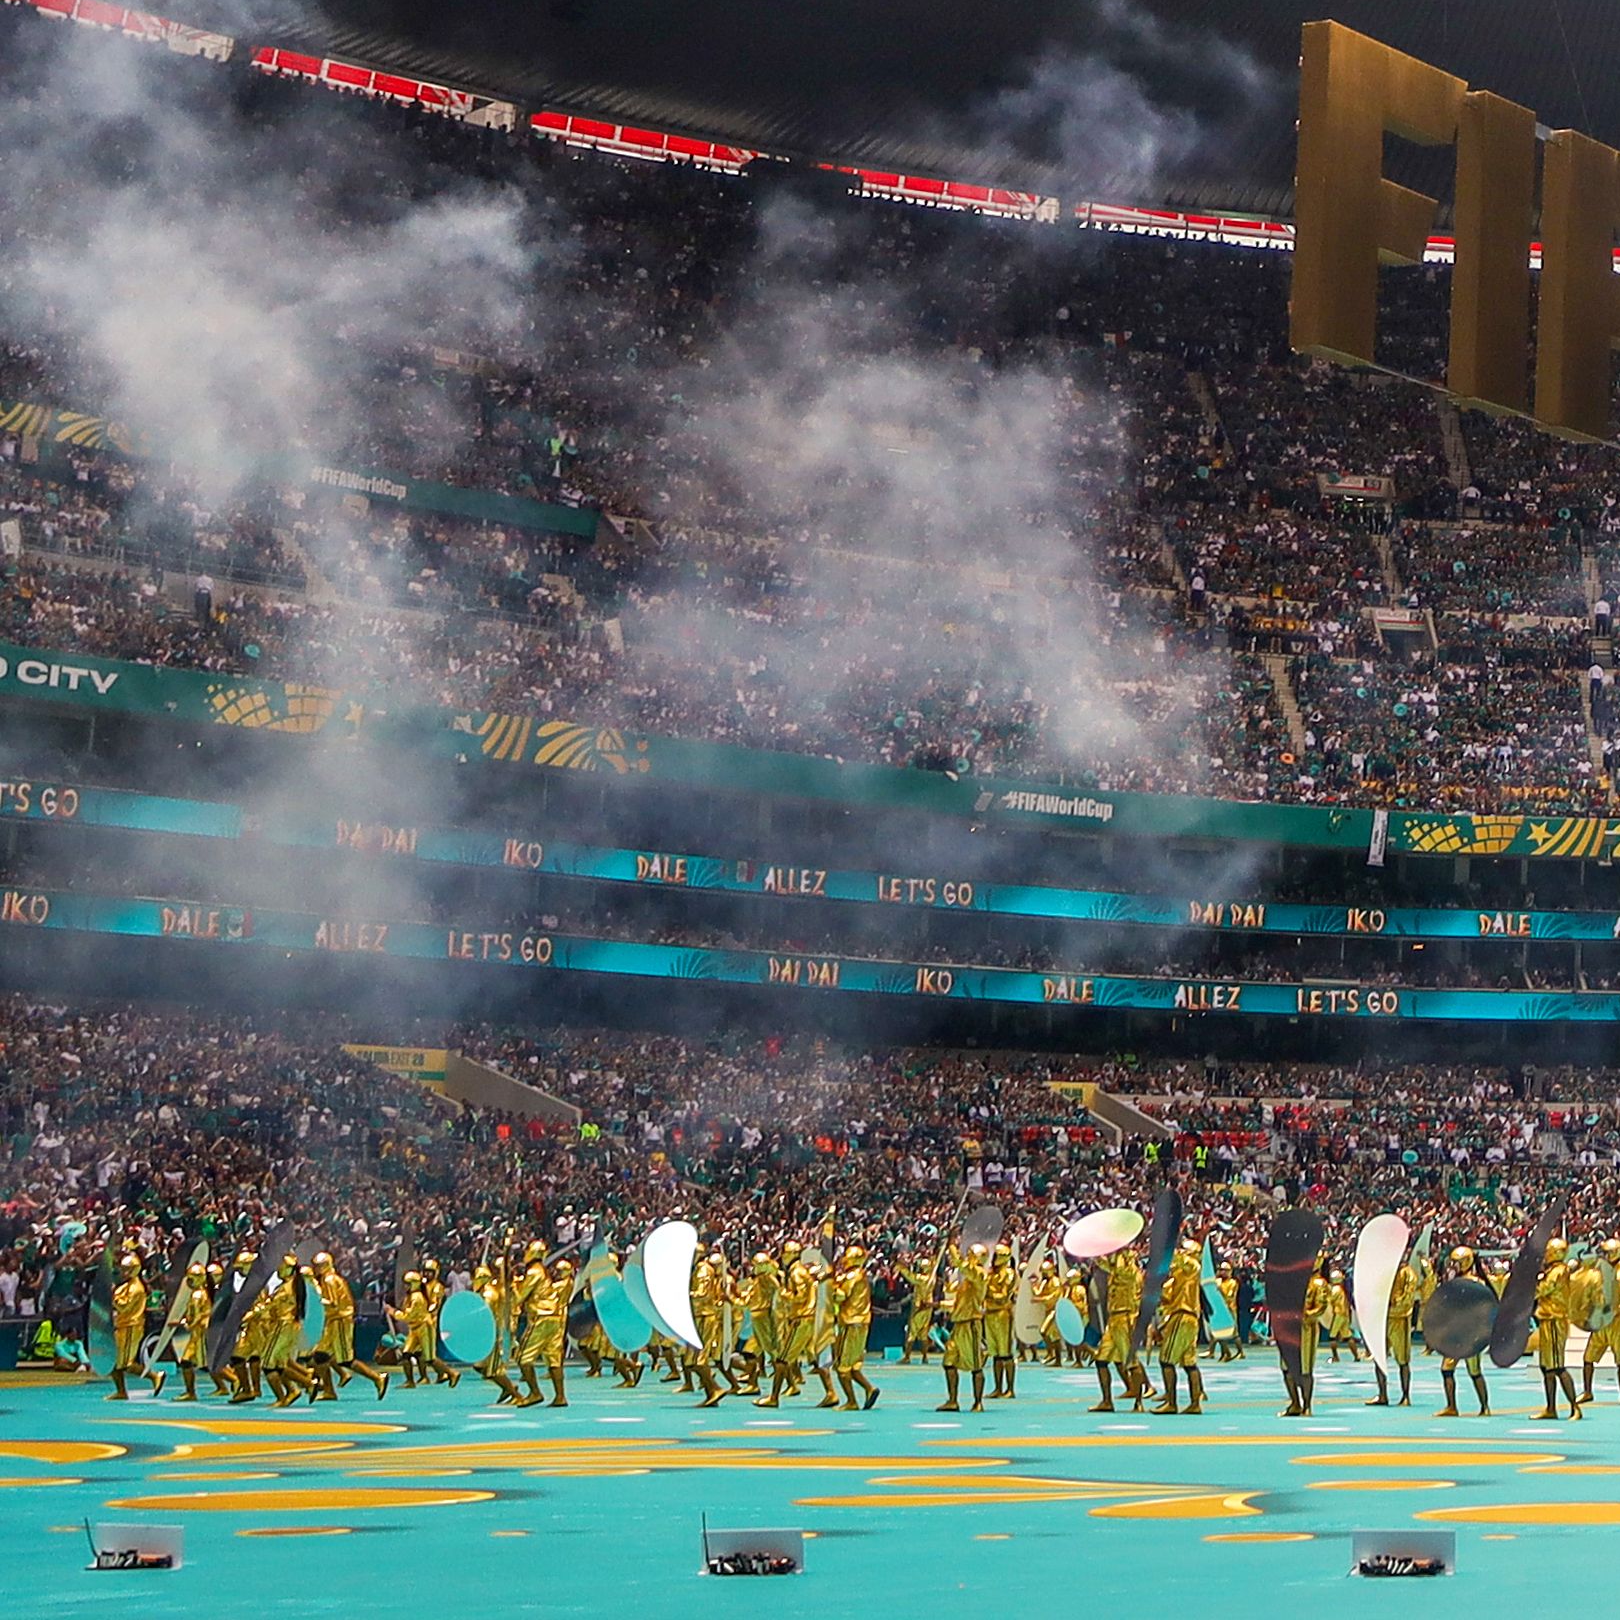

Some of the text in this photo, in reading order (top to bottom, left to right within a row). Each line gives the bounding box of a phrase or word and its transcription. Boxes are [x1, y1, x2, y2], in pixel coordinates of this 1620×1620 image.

[17, 660, 119, 695] CITY
[41, 788, 78, 816] GO
[1001, 790, 1114, 822] #FIFAWorldCup
[381, 827, 417, 855] DAI
[503, 839, 543, 868] IKO
[636, 854, 688, 883] DALE
[764, 866, 826, 895] ALLEZ
[878, 875, 973, 906] LET'S GO
[1, 891, 49, 925] IKO
[161, 906, 220, 938] DALE
[1190, 900, 1264, 928] DAI DAI
[1347, 908, 1385, 932] IKO
[1479, 912, 1531, 937] DALE
[447, 930, 552, 964] LET'S GO
[768, 956, 840, 988] DAI DAI
[916, 968, 953, 995] IKO
[1043, 979, 1094, 1004] DALE
[1174, 984, 1240, 1011] ALLEZ
[1297, 987, 1398, 1014] LET'S GO
